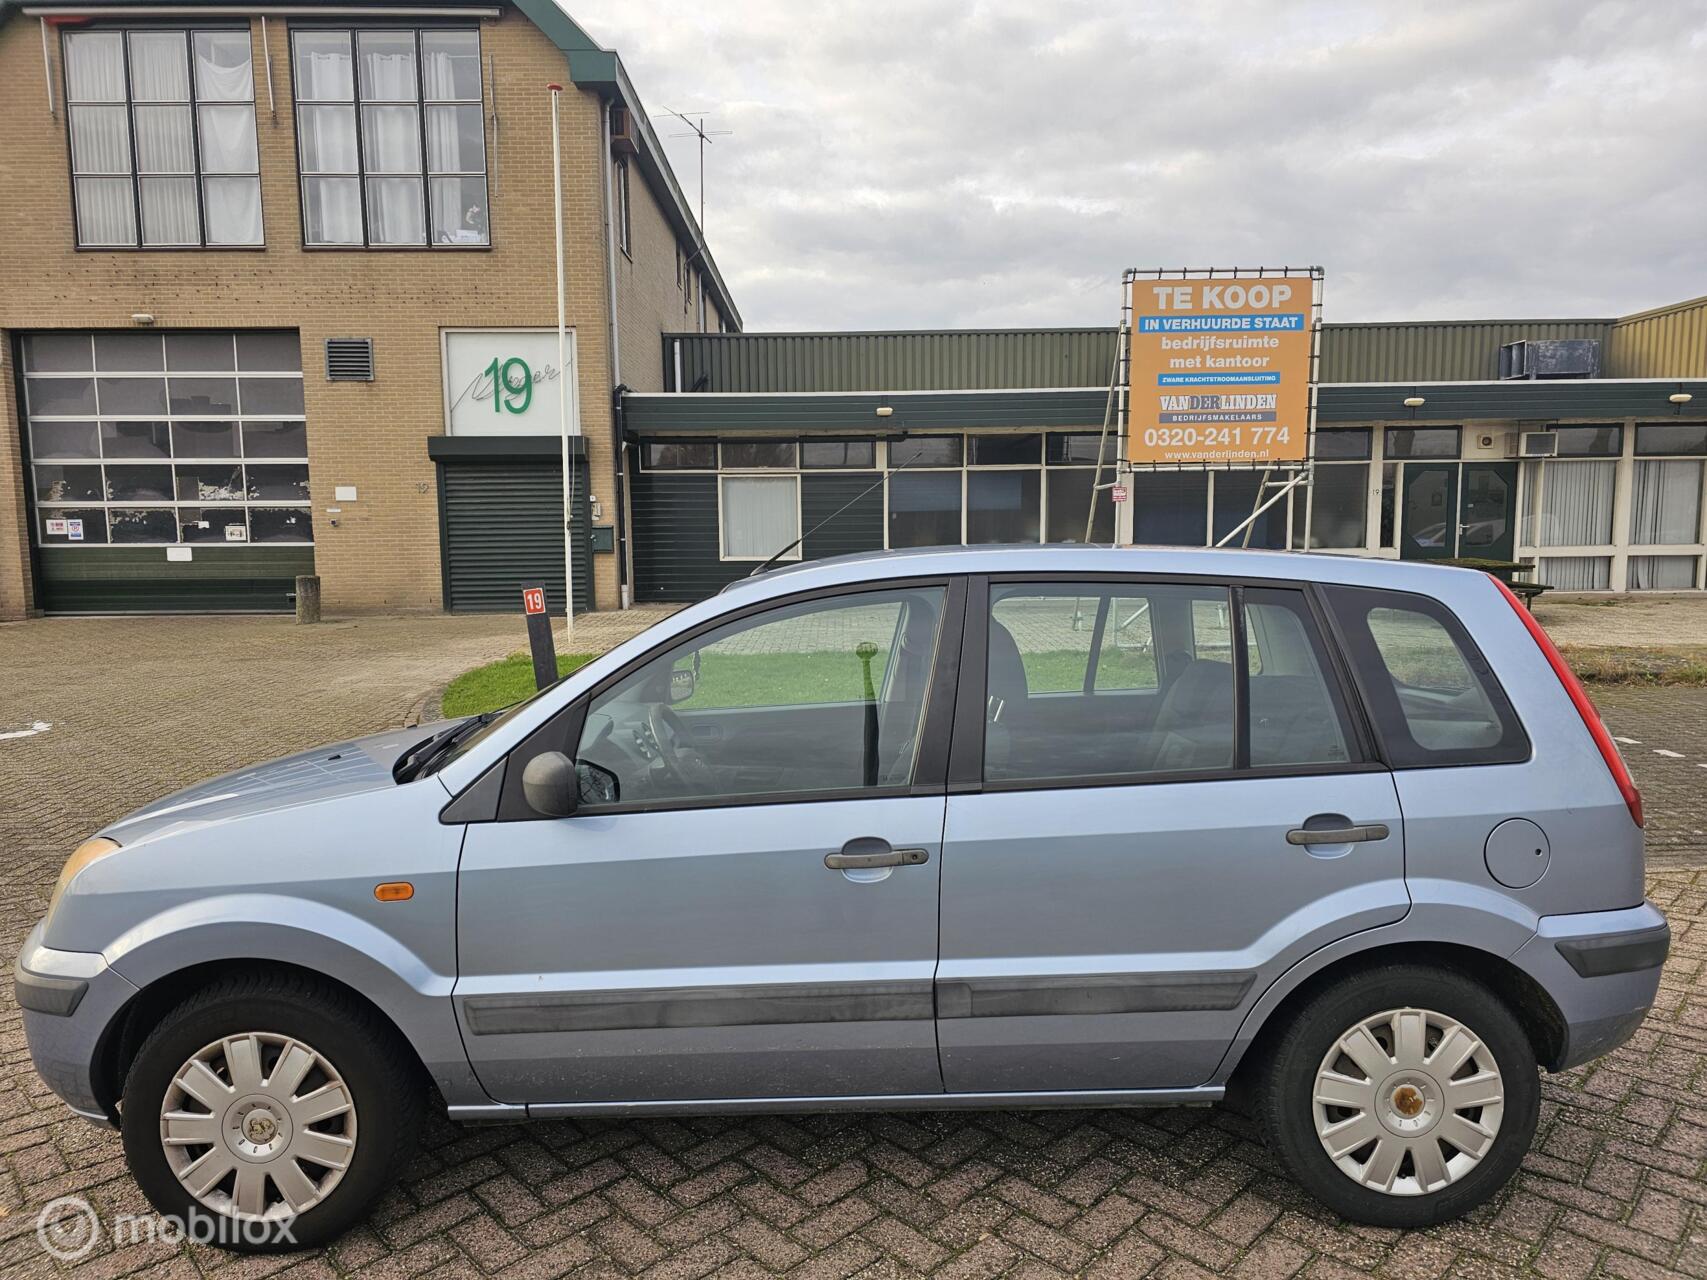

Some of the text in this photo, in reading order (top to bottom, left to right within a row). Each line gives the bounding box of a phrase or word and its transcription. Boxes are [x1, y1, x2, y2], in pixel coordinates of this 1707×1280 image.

[1152, 284, 1292, 310] TE KOOP
[1144, 316, 1298, 331] IN VERHUURDE STAAT
[1161, 334, 1280, 351] bedrijfsruimte
[1169, 354, 1270, 369] met kantoor
[484, 356, 532, 414] 19
[1172, 413, 1263, 422] BEDRIJFSMAKELAARS
[1144, 426, 1290, 447] 0320-241 774
[1164, 449, 1269, 460] www.vanderlinden.nl
[527, 592, 542, 610] 19
